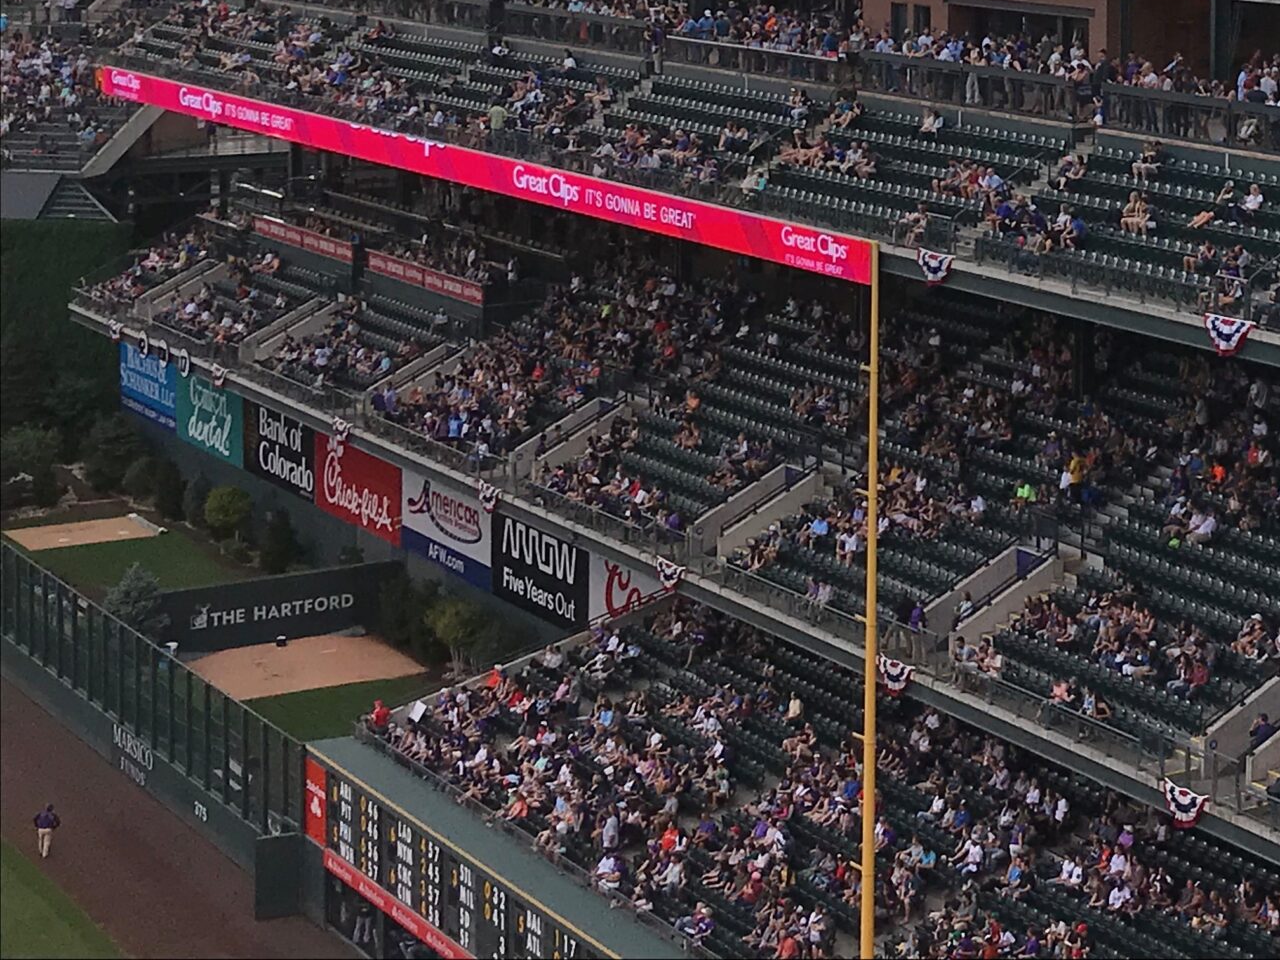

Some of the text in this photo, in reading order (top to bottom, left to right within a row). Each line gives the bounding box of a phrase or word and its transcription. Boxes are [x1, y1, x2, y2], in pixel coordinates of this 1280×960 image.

[179, 87, 202, 109] Great
[202, 93, 222, 119] Clips
[513, 165, 693, 230] Great Clips IT'S GONNA BE GREAT
[781, 226, 847, 262] Great Clips
[259, 407, 303, 452] Bank of
[259, 441, 313, 492] Colorado
[324, 451, 393, 532] Chick-fil-A
[408, 480, 480, 526] American
[428, 543, 465, 574] AFW.com
[502, 518, 577, 585] ARROW
[210, 594, 354, 627] THE HARTFORD
[503, 567, 576, 622] Five Years Out
[113, 723, 153, 770] MARSICO
